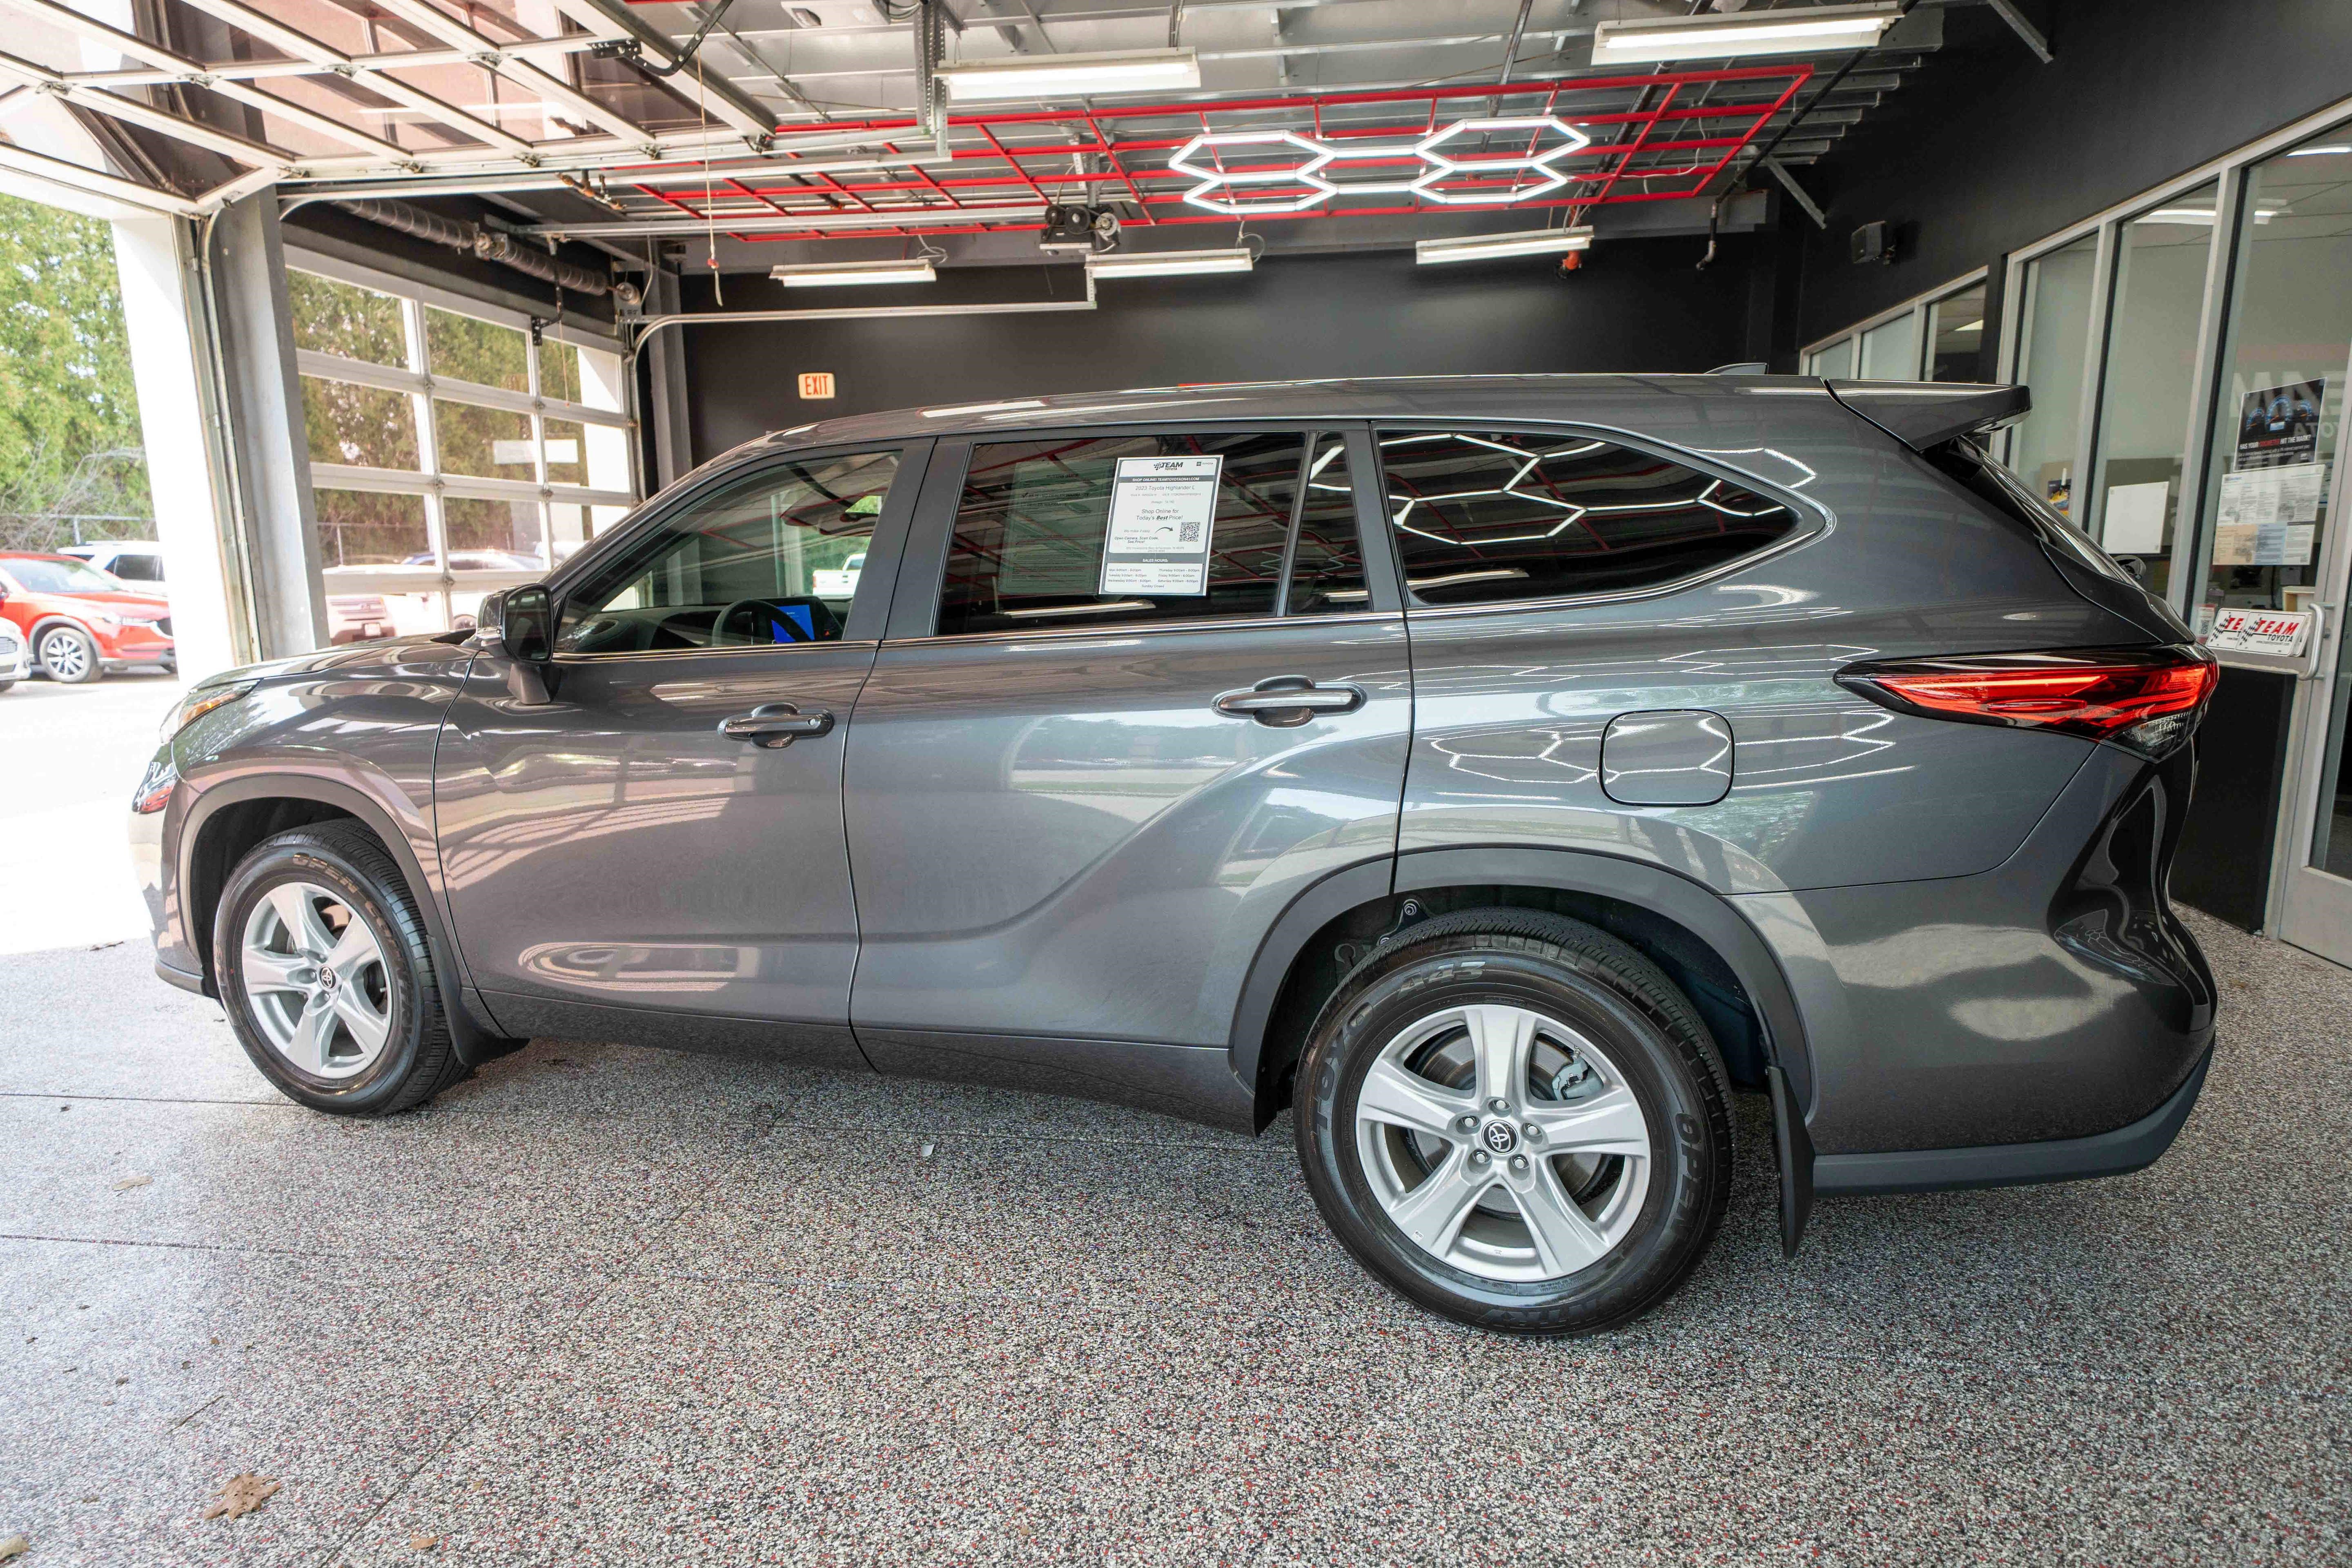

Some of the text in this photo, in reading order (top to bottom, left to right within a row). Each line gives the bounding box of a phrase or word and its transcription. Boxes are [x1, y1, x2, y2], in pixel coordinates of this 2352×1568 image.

[805, 375, 828, 395] EXIT
[2224, 617, 2244, 630] TE
[2254, 620, 2300, 635] TEAM
[2267, 634, 2293, 642] TOYOTA
